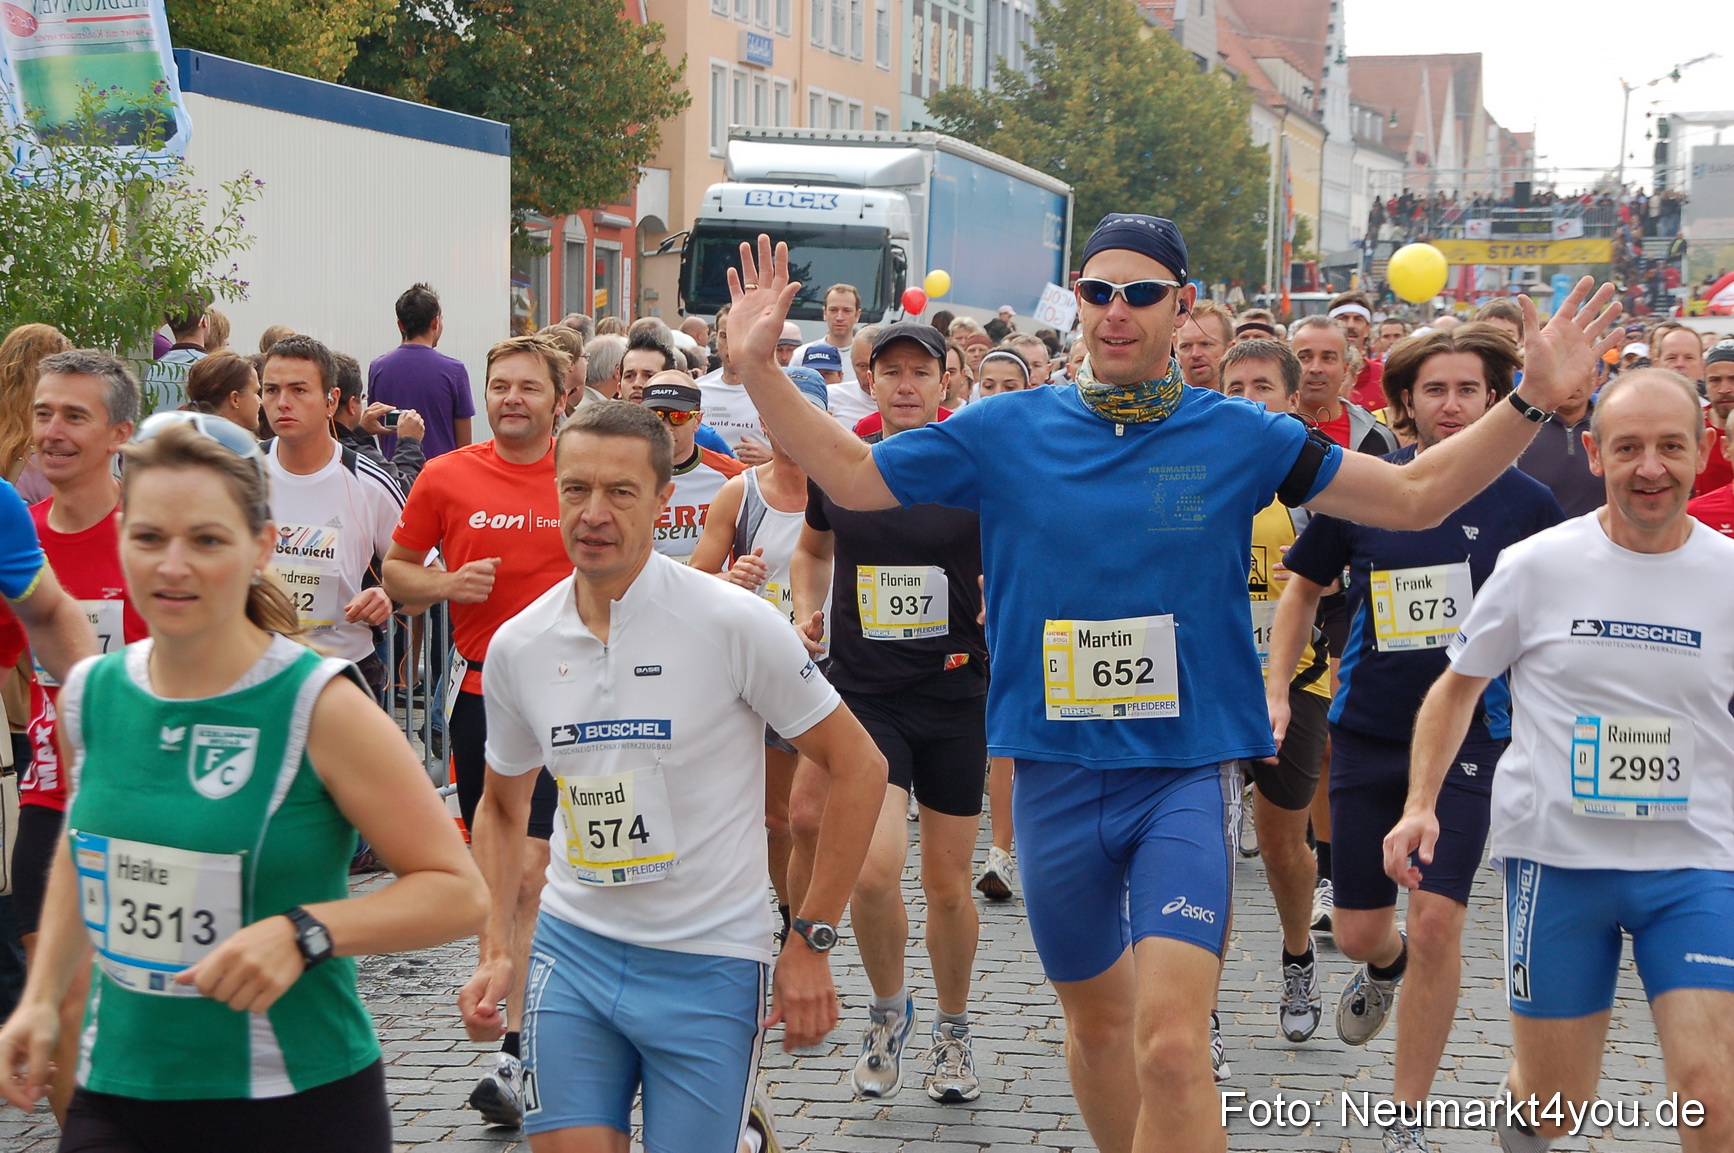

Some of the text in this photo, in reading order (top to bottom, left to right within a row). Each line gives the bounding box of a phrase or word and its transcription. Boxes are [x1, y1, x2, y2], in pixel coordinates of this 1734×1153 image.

[745, 190, 839, 210] BOCK
[1488, 245, 1549, 260] START
[1159, 473, 1207, 481] STADTLAUF
[301, 545, 335, 559] viertl
[880, 572, 921, 586] Florian
[1395, 574, 1433, 591] Frank
[890, 595, 933, 616] 937
[1408, 597, 1457, 621] 673
[1078, 628, 1133, 648] Martin
[1609, 622, 1698, 646] BÜSCHEL
[1050, 659, 1058, 673] C
[1093, 657, 1155, 687] 652
[1127, 700, 1177, 711] PFLEIDERER
[585, 722, 666, 740] BÜSCHEL
[1608, 724, 1672, 744] Raimund
[621, 742, 672, 751] WERKZEUGBAU
[1609, 756, 1681, 782] 2993
[569, 782, 626, 806] Konrad
[588, 814, 650, 849] 574
[117, 854, 170, 886] Heike
[119, 898, 217, 946] 3513
